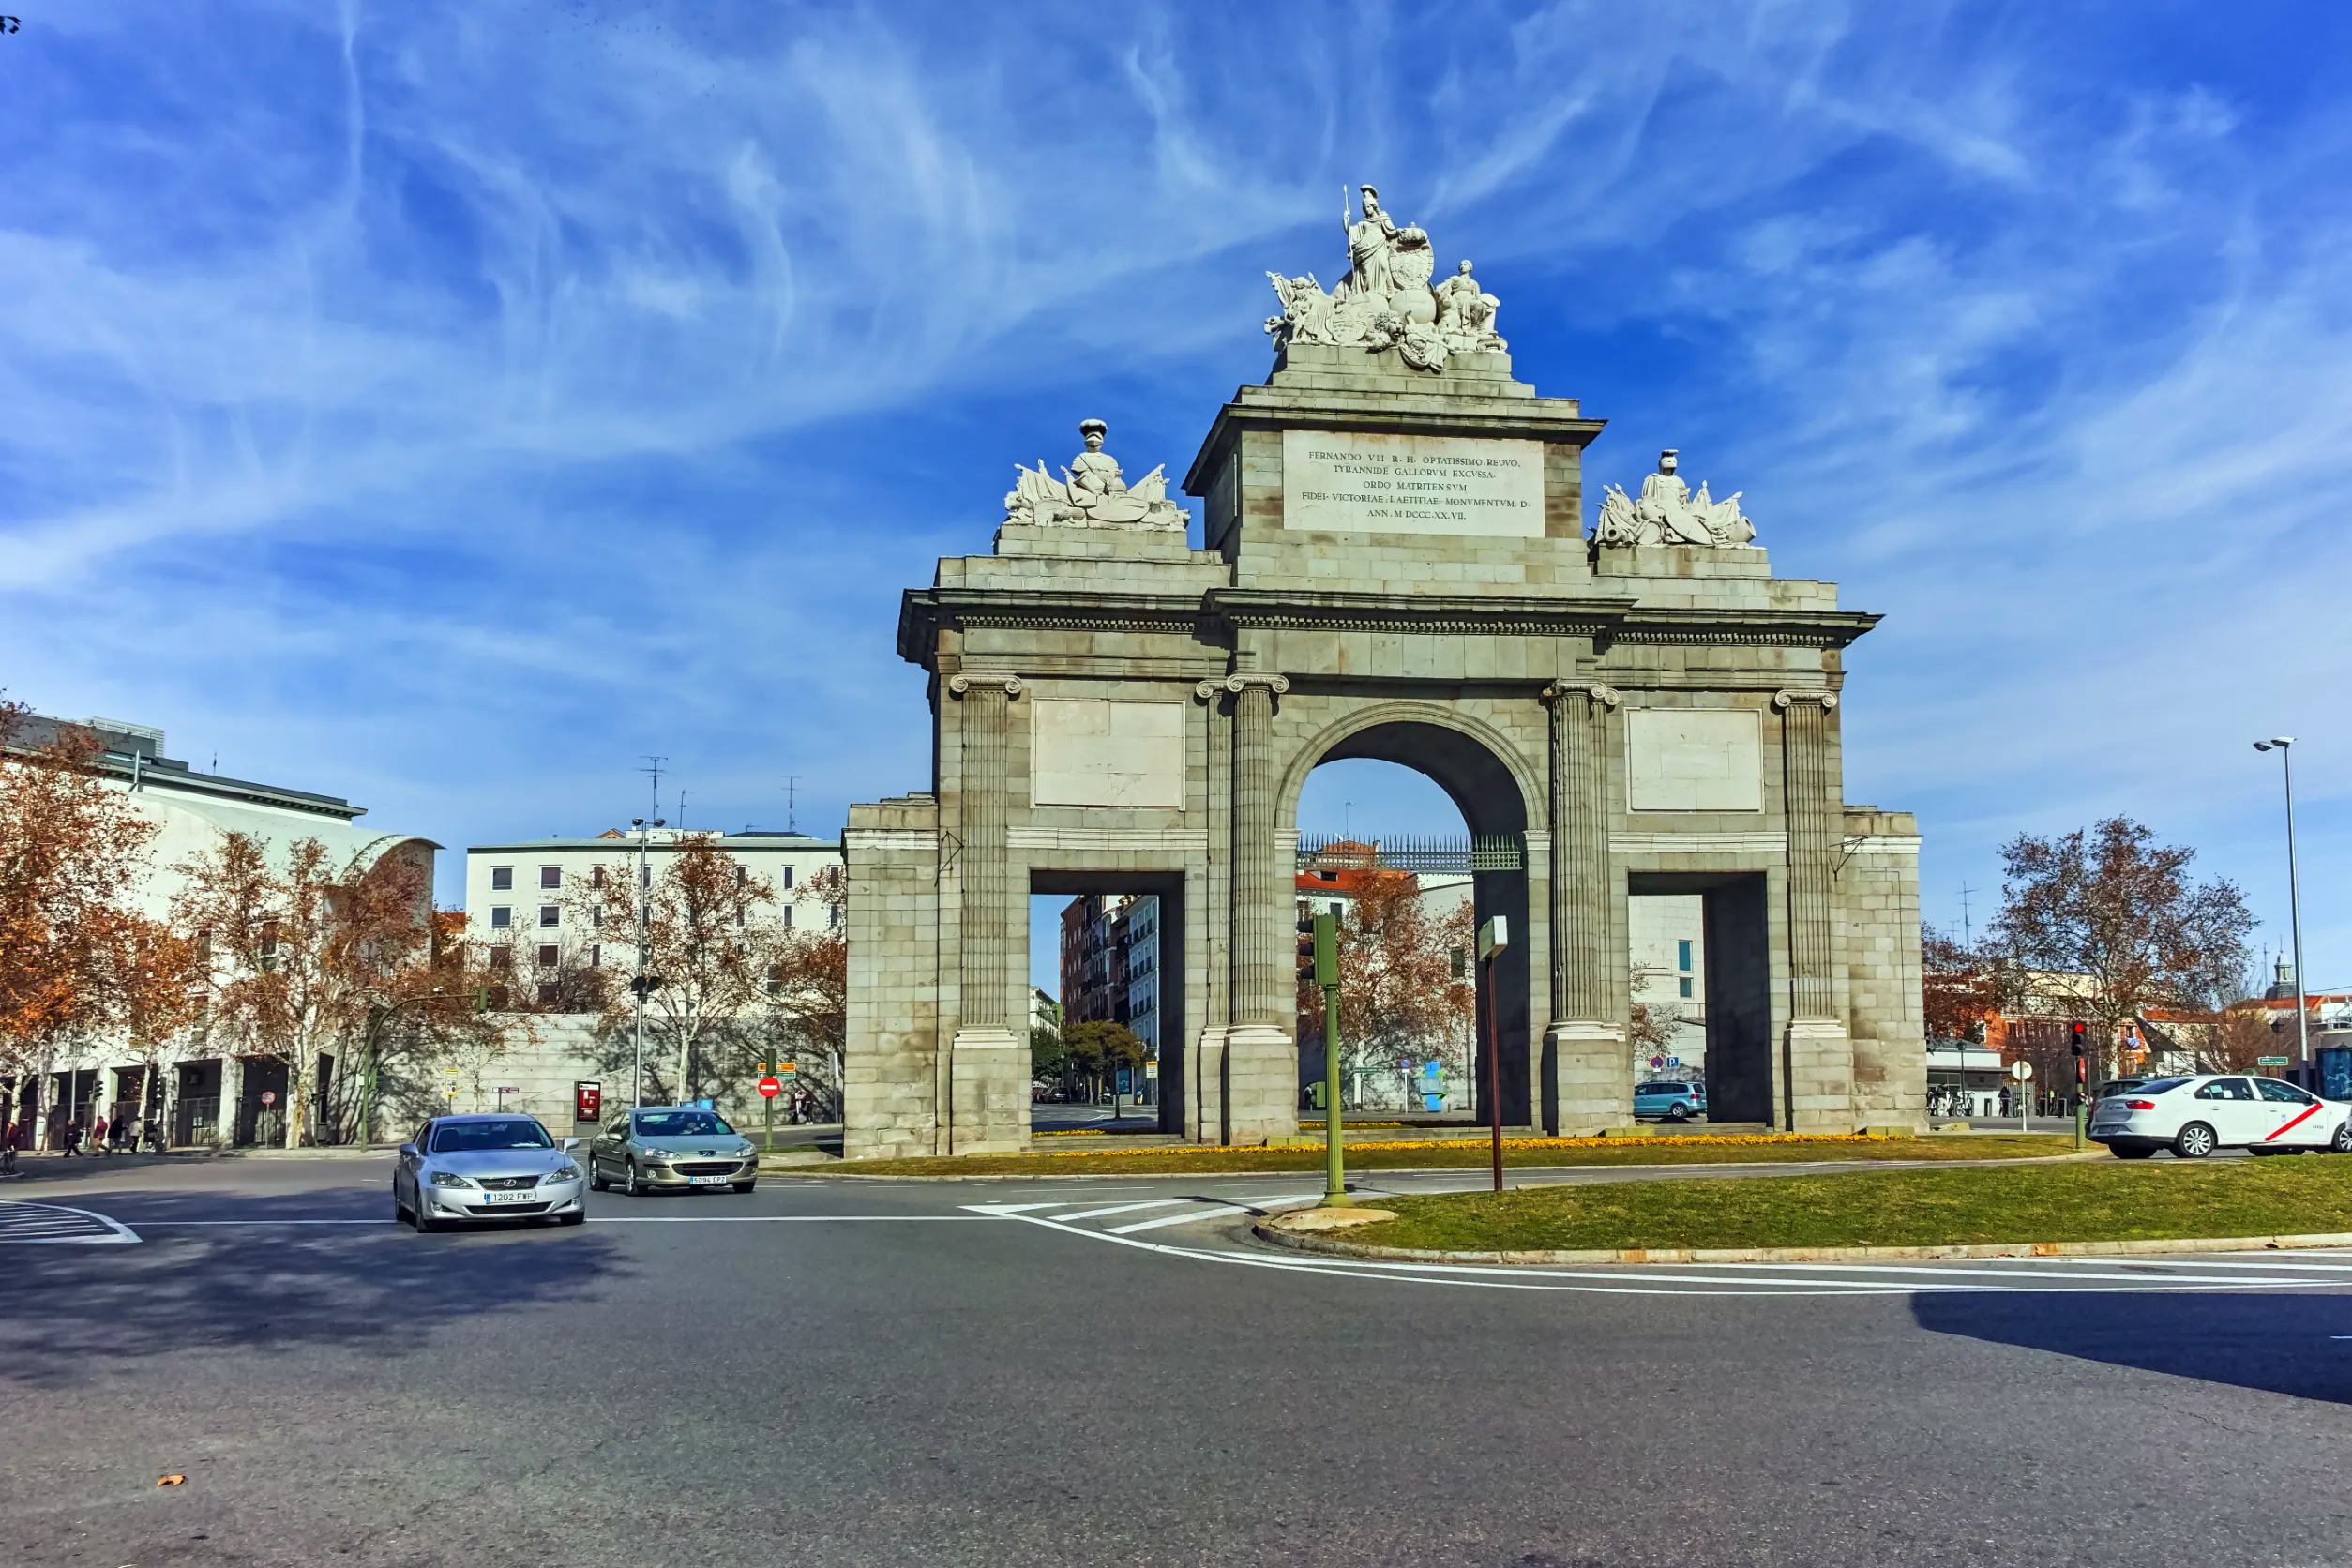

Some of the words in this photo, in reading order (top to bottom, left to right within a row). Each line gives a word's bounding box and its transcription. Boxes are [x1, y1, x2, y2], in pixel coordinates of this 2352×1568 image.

[1308, 451, 1362, 460] FERNANDO
[1368, 454, 1385, 462] VII
[1334, 465, 1389, 475] TYRANNIDE
[1395, 467, 1447, 477] GALLORVM
[1452, 470, 1496, 478] EXCVSSA.
[493, 1193, 514, 1201] 1202
